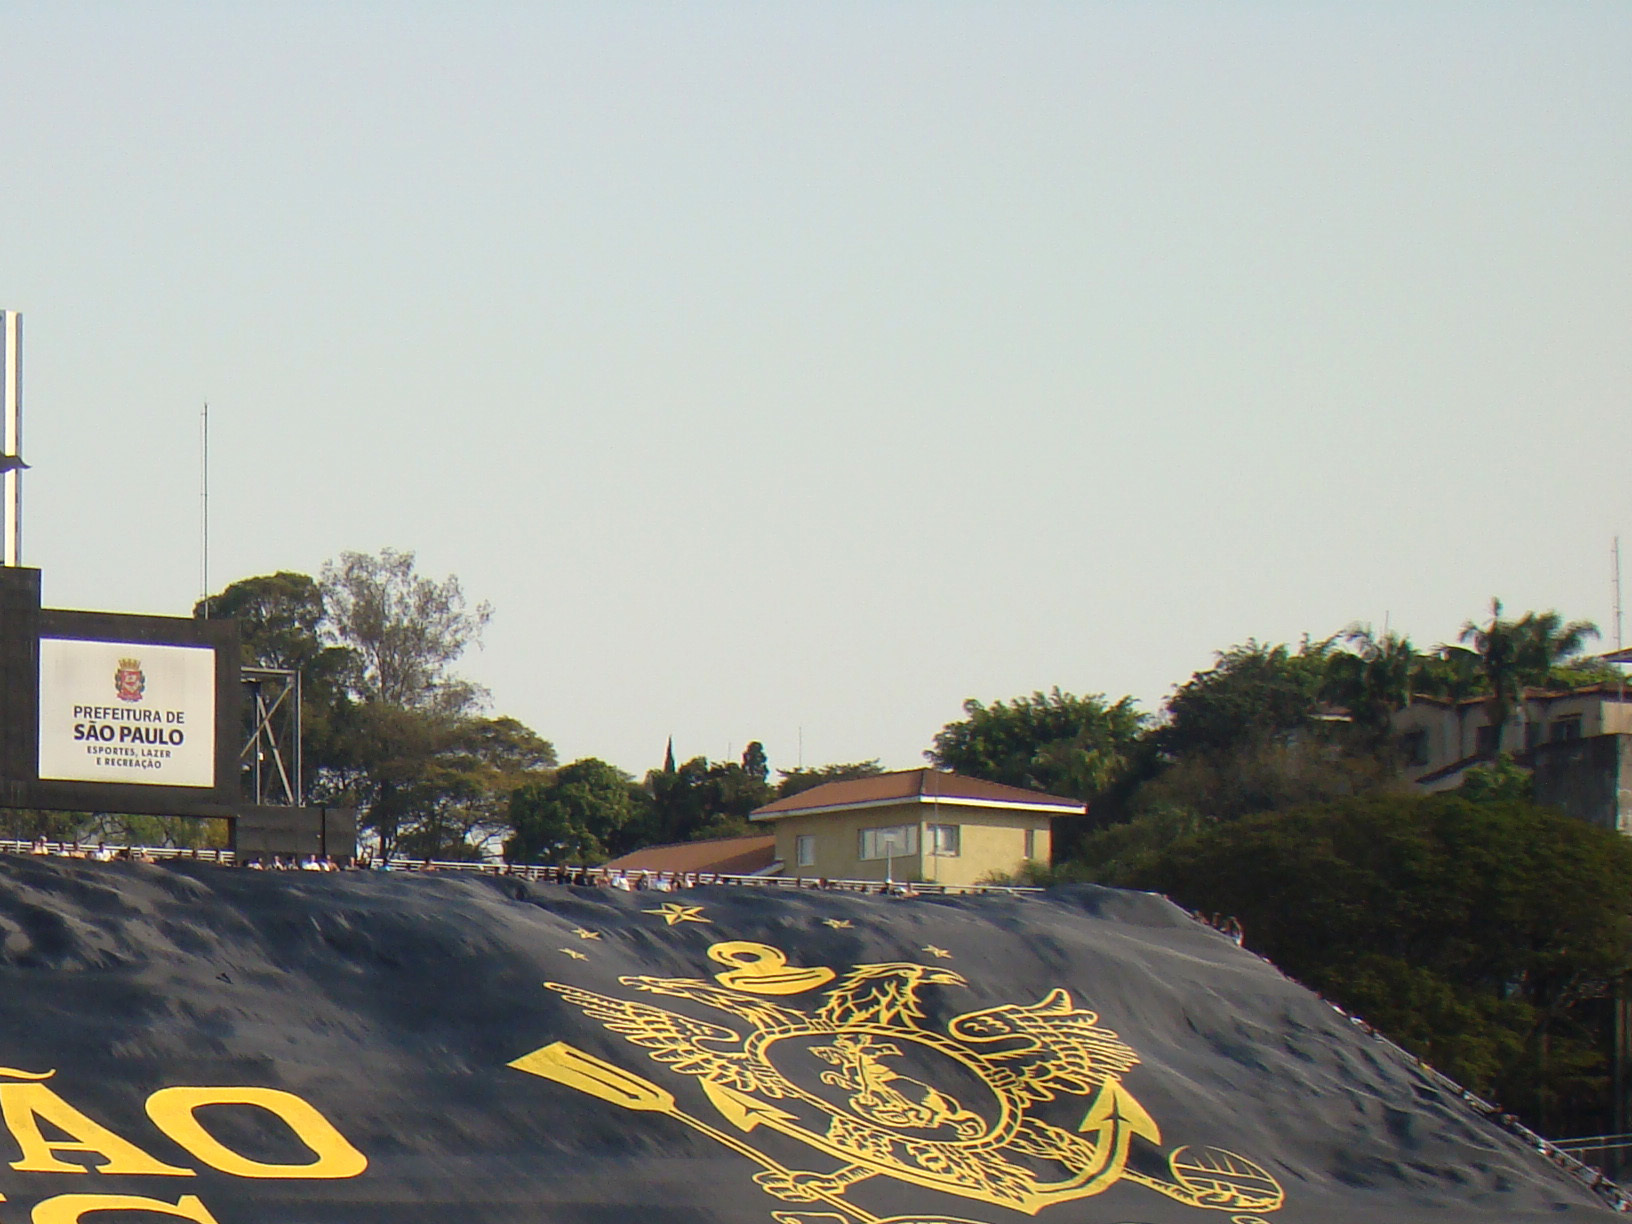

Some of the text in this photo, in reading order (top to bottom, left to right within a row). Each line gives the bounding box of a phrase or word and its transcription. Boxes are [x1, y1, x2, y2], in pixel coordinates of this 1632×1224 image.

[73, 705, 185, 724] PREFEITURA DE
[73, 720, 184, 746] SÃO PAULO
[87, 746, 171, 759] ESPORTES, LAZER
[96, 757, 101, 766] E
